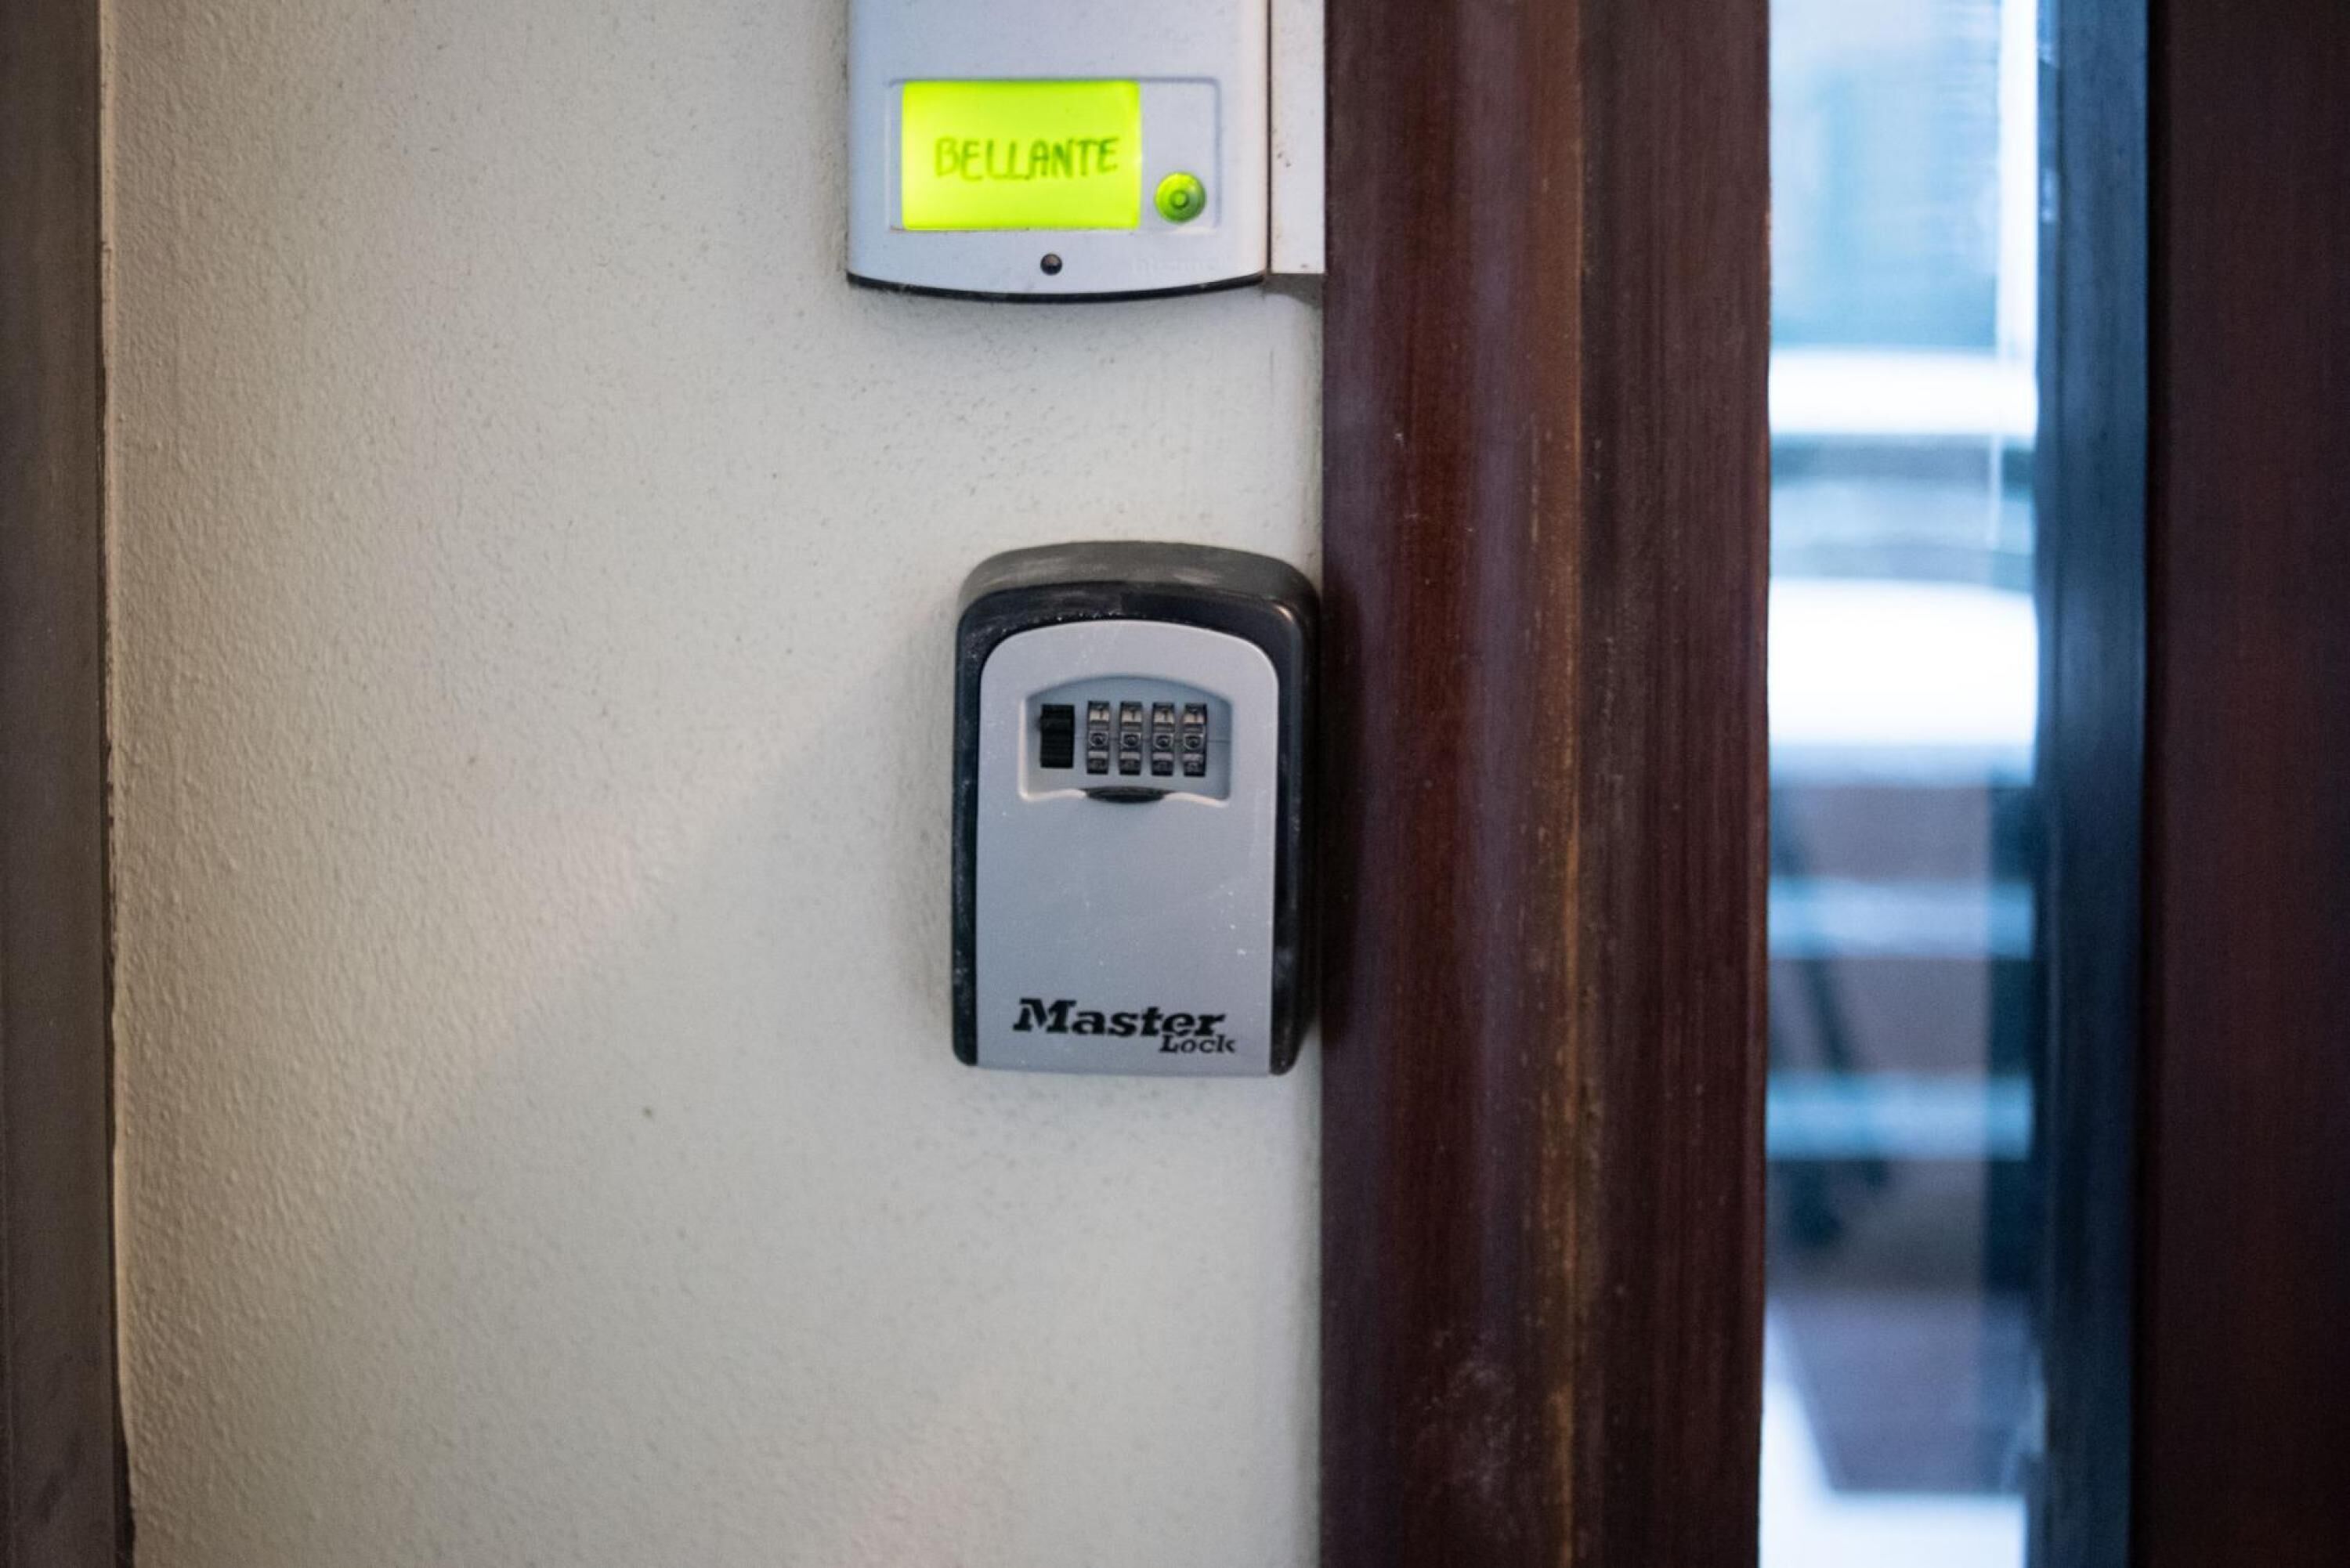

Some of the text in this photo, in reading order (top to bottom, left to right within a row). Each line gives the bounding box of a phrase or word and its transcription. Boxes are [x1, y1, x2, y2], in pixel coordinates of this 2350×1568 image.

[935, 137, 1120, 181] BELLANTE
[1012, 997, 1227, 1037] Master
[1159, 1034, 1236, 1054] Lock
